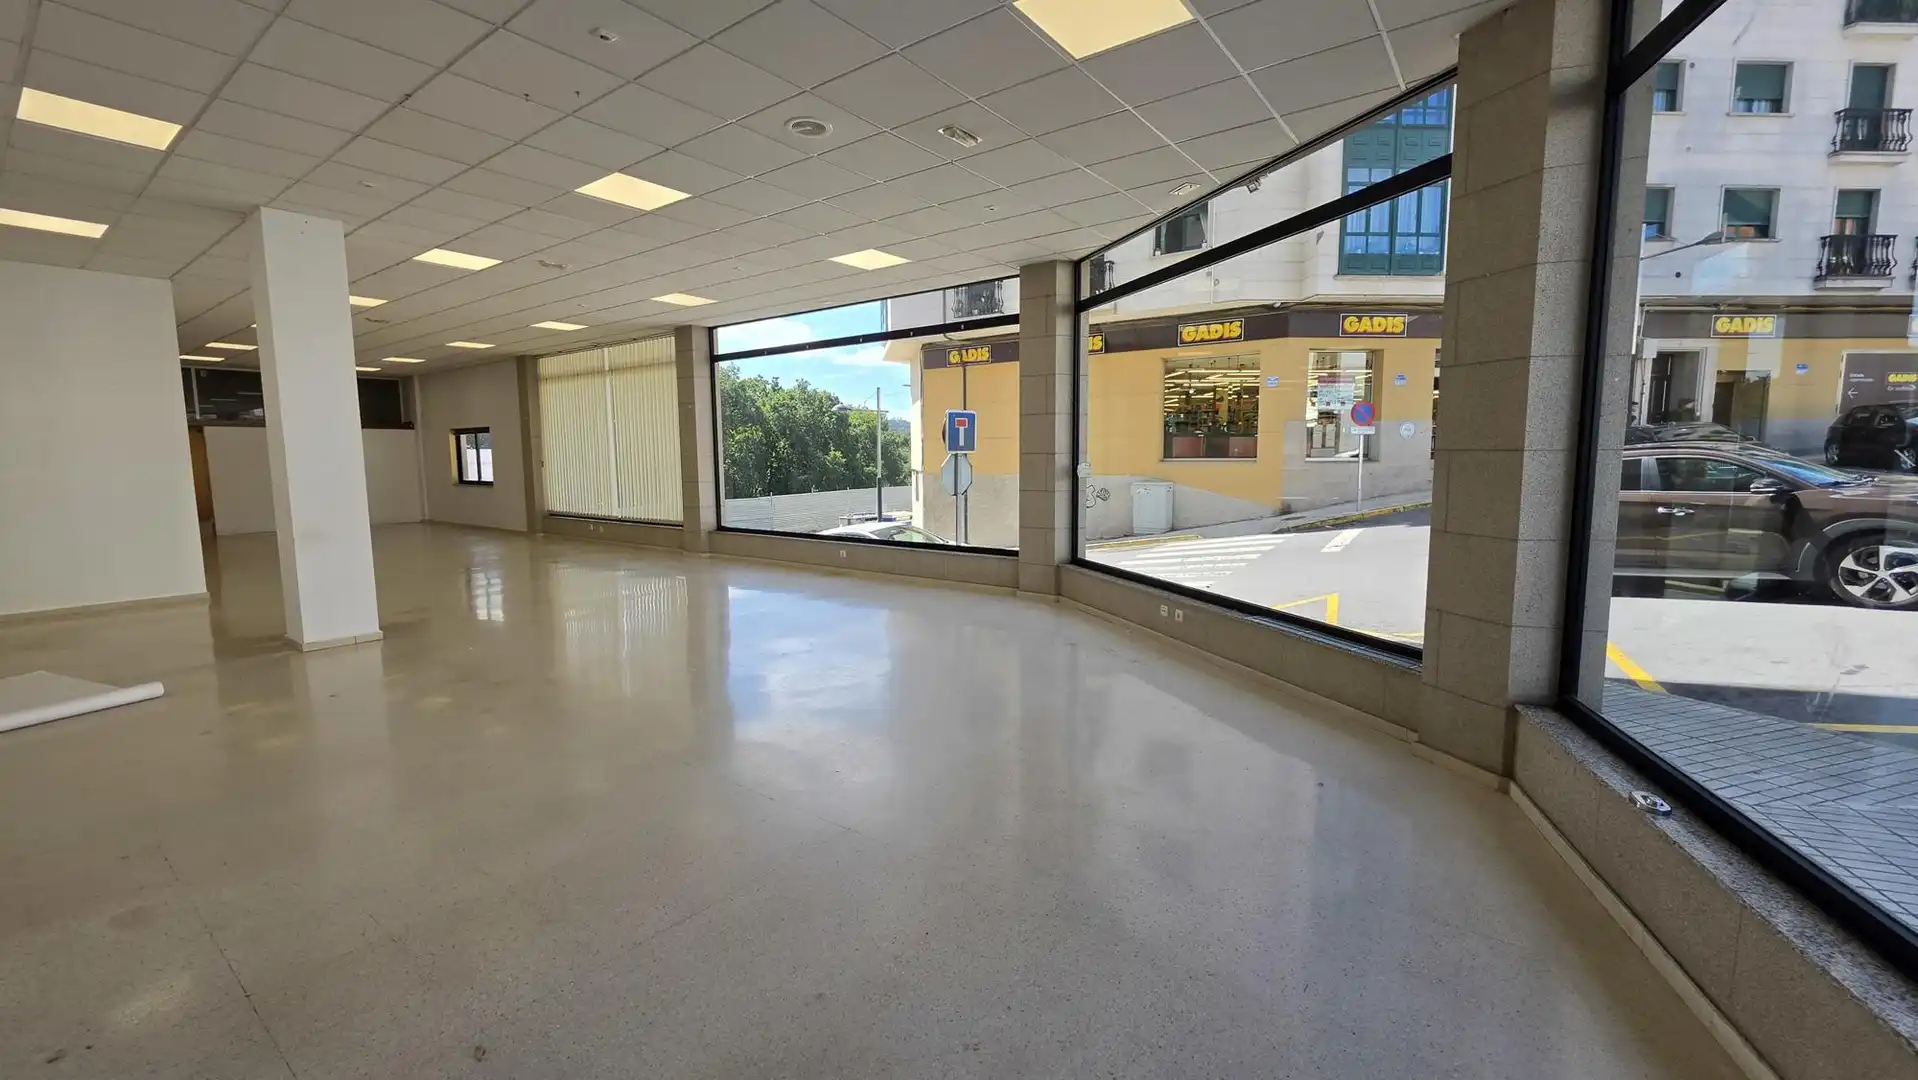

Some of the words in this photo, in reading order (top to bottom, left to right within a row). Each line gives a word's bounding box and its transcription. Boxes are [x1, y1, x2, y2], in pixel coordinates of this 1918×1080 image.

[1182, 321, 1242, 342] GADIS
[1343, 316, 1405, 333] GADIS
[1715, 317, 1774, 333] GADIS
